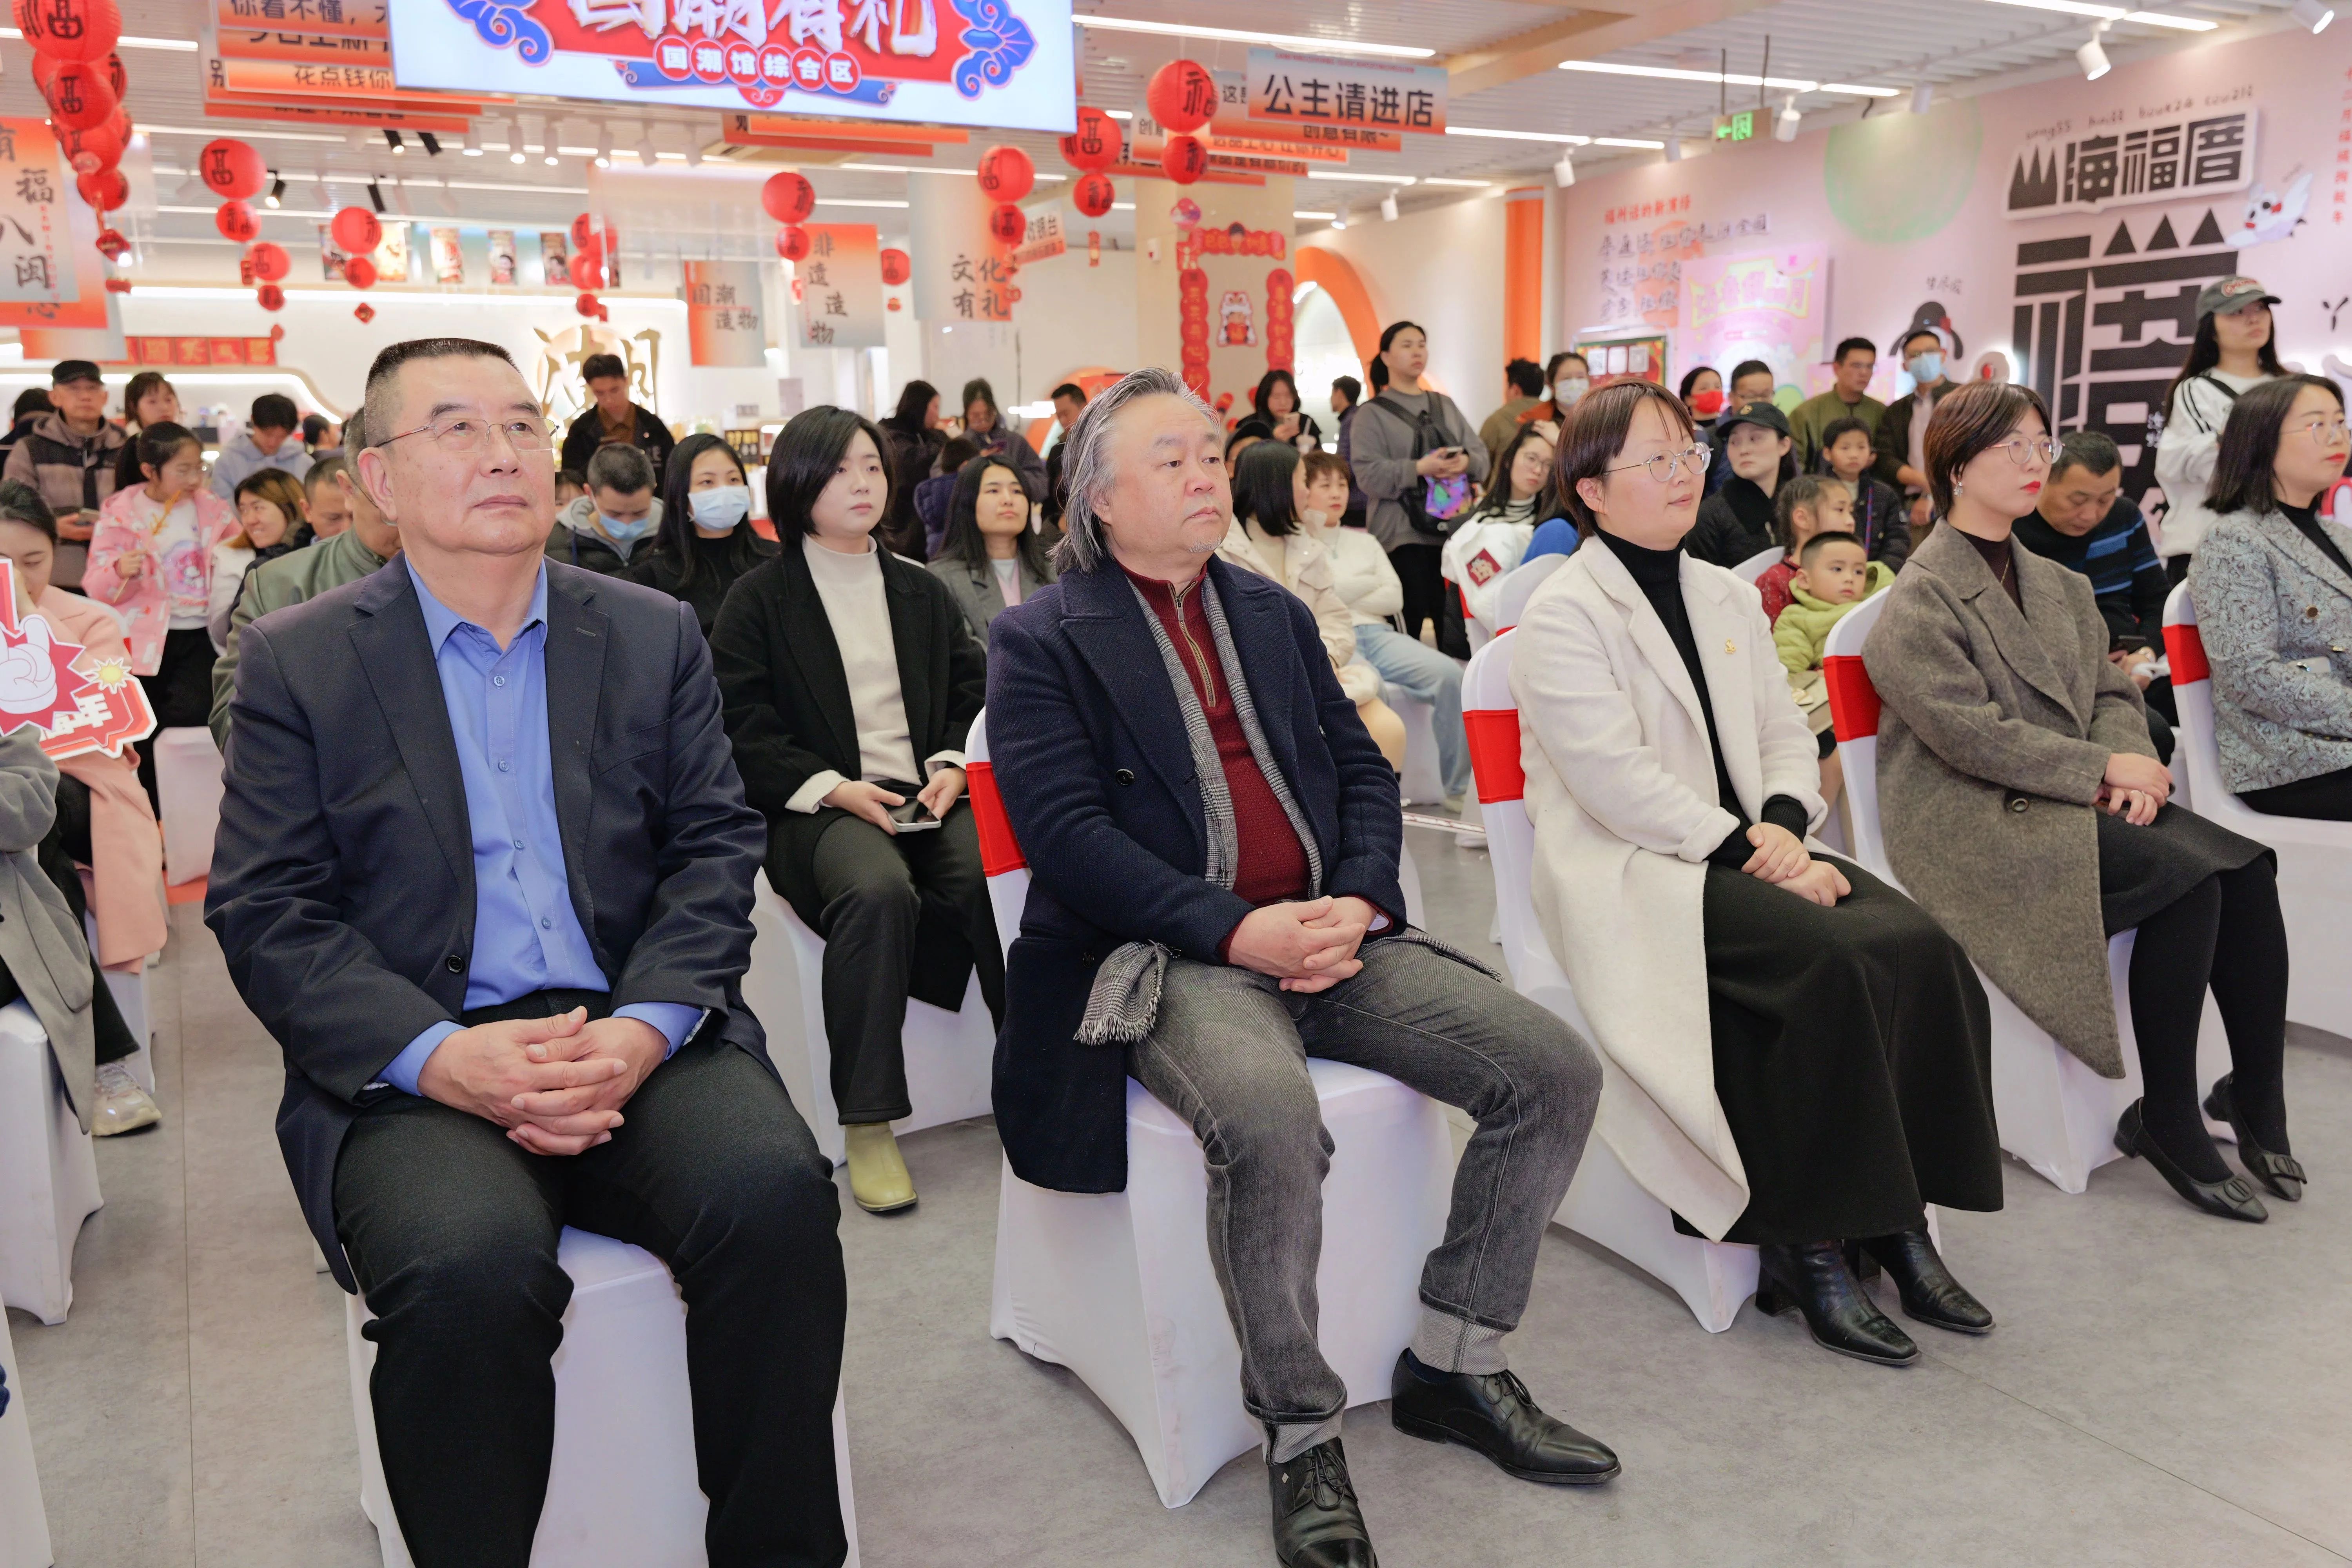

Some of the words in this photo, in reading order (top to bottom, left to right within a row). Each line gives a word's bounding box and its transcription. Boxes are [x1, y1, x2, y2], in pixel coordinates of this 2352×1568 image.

[662, 45, 854, 84] 国潮馆综合区
[1263, 74, 1433, 128] 公主请进店
[953, 254, 1007, 282] 文化
[953, 288, 1009, 318] 有礼
